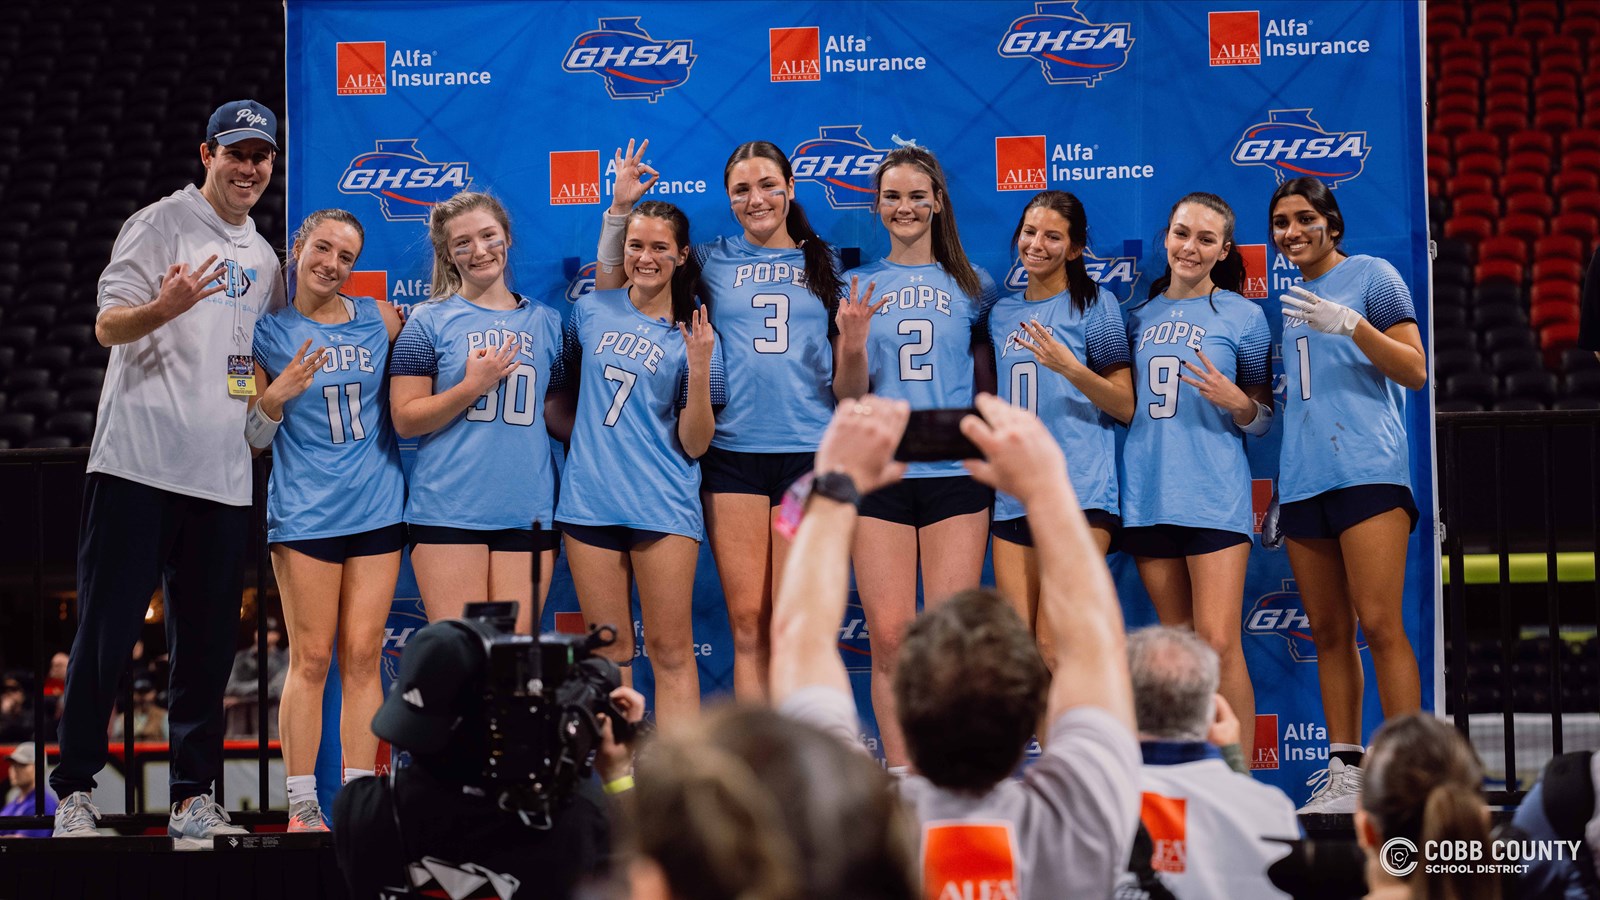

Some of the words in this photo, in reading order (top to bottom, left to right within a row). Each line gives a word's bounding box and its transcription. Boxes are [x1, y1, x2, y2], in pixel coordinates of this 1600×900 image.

[1003, 28, 1127, 53] GHSA
[1217, 43, 1259, 58] ALFA
[1266, 39, 1370, 57] Insurance
[567, 44, 690, 68] GHSA
[778, 60, 819, 74] ALFA
[826, 55, 926, 72] Insurance
[344, 73, 386, 88] ALFA
[392, 70, 492, 87] Insurance
[236, 109, 268, 127] Pope
[1236, 136, 1364, 160] GHSA
[791, 154, 884, 177] GHS
[1005, 168, 1047, 183] ALFA
[1052, 164, 1154, 182] Insurance
[342, 167, 465, 189] GHSA
[557, 183, 599, 197] ALFA
[733, 262, 808, 289] POPE
[880, 285, 952, 317] POPE
[752, 293, 790, 355] 3
[1137, 321, 1207, 353] POPE
[593, 331, 665, 375] POPE
[897, 318, 934, 381] 2
[1296, 336, 1312, 401] 1
[603, 363, 638, 427] 7
[1010, 360, 1039, 415] 0
[1148, 355, 1181, 420] 9
[322, 382, 366, 444] 11
[1284, 723, 1327, 741] Alfa
